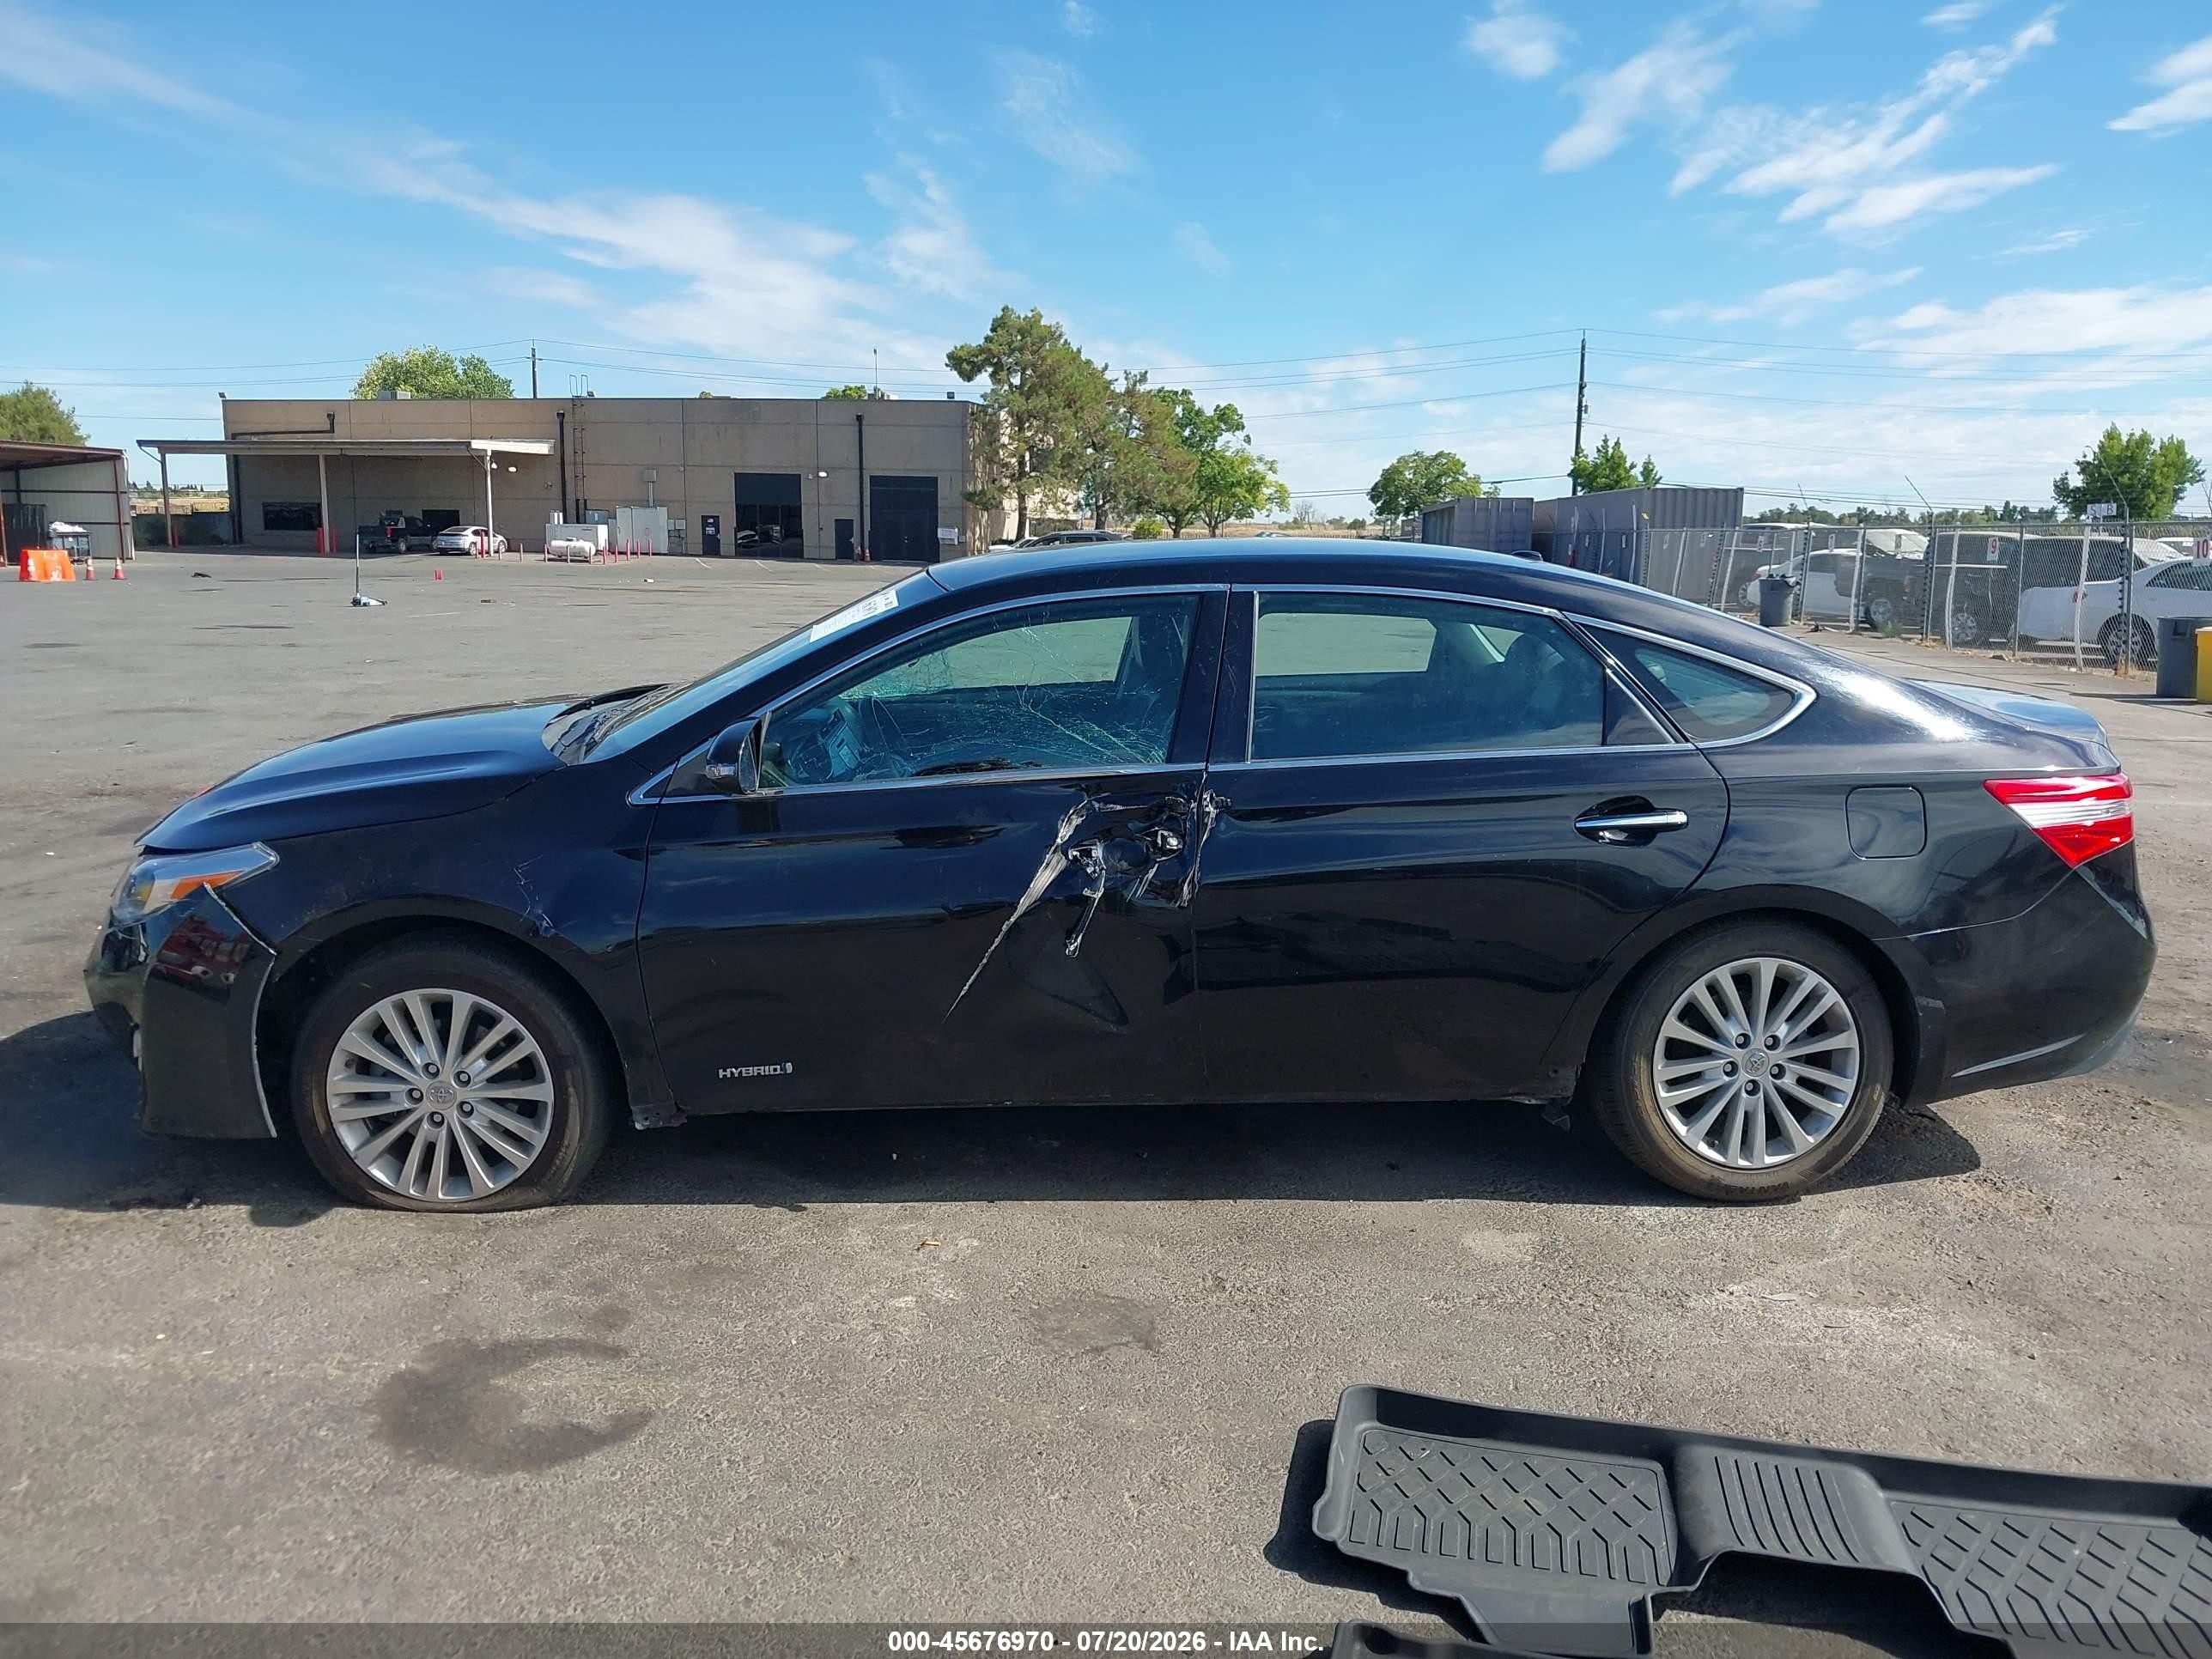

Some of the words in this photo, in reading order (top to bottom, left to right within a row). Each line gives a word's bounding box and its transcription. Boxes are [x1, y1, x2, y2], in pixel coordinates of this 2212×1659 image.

[2106, 504, 2114, 515] B
[1990, 538, 1997, 555] 9
[2197, 538, 2209, 559] 10
[718, 1065, 781, 1079] HYBRID
